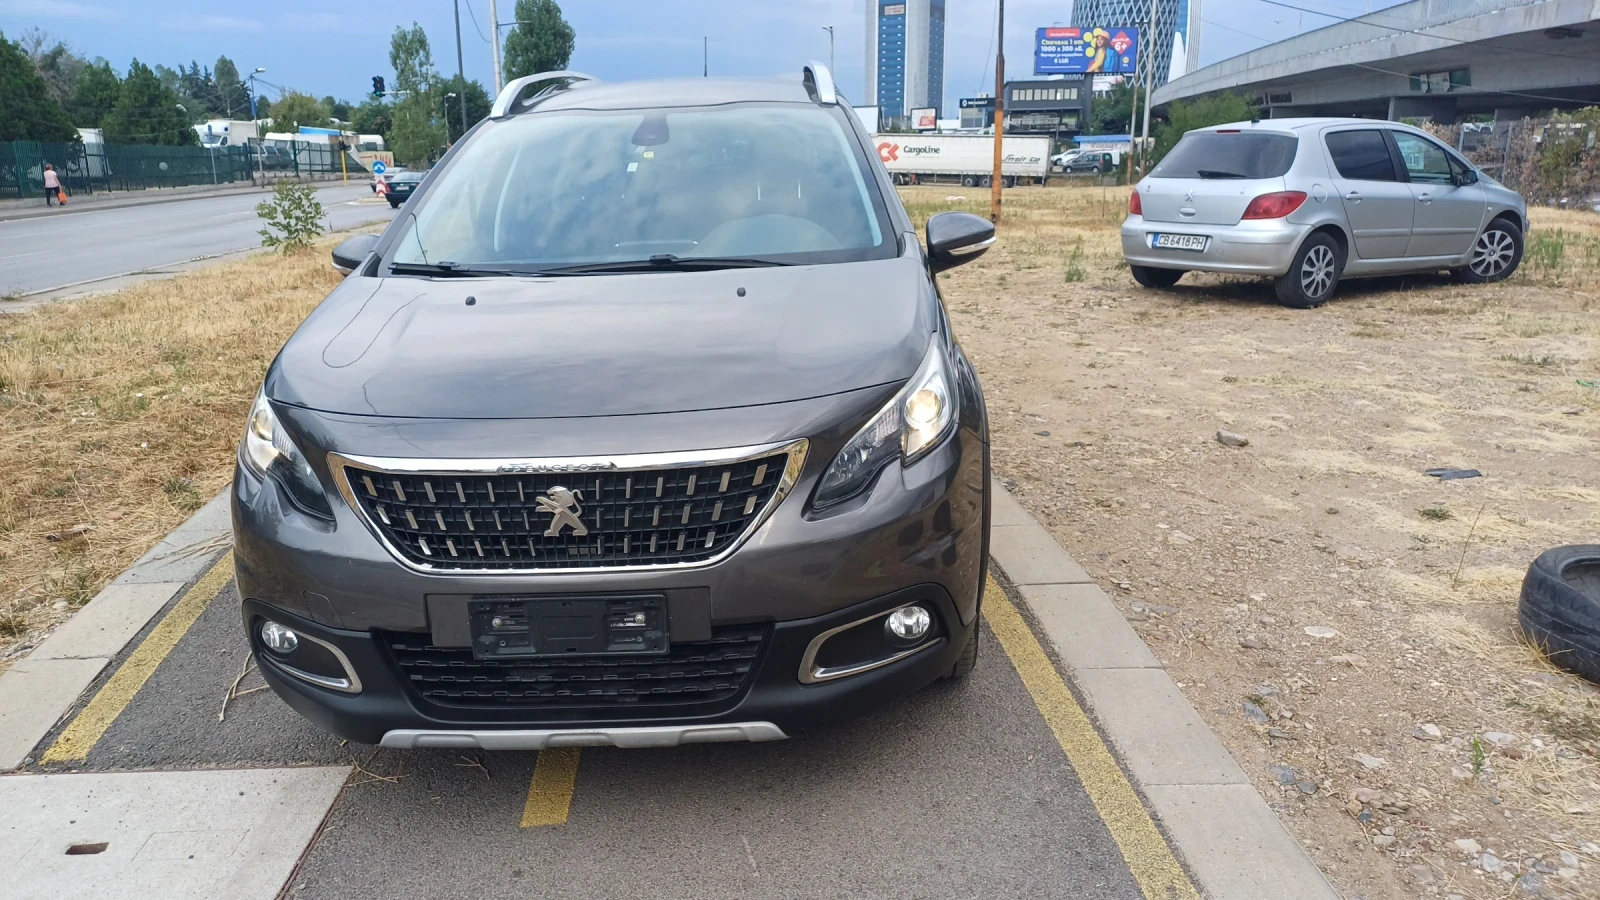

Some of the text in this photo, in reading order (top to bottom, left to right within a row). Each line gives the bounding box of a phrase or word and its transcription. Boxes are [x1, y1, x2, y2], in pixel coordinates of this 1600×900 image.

[904, 145, 940, 156] CargoLine
[1158, 235, 1204, 248] CB 6418 PH
[512, 464, 601, 472] PEUGEOT
